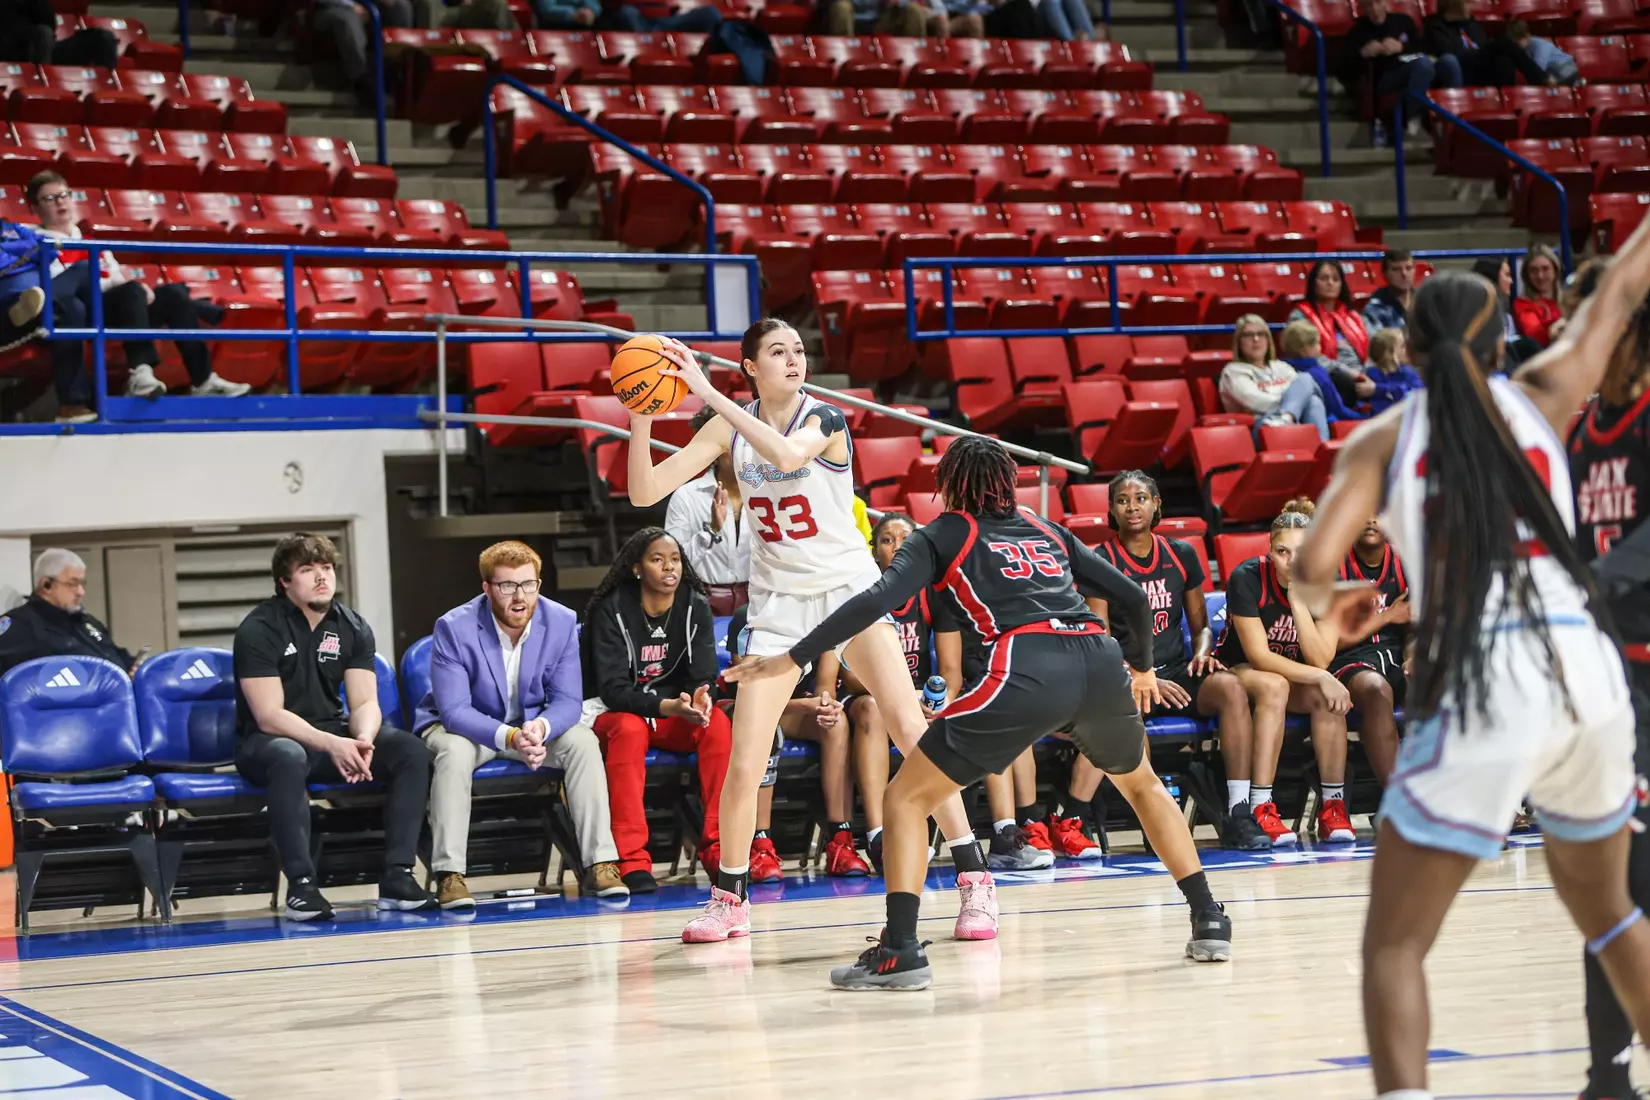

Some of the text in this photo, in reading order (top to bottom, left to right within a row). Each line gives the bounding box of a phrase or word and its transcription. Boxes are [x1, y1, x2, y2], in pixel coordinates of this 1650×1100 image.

[738, 462, 765, 489] Lady
[1589, 457, 1629, 489] JAX
[1578, 479, 1637, 524] STATE
[748, 494, 819, 543] 33
[988, 540, 1065, 580] 35
[898, 621, 918, 640] AX
[1267, 626, 1299, 642] STAT
[1274, 613, 1294, 629] JA
